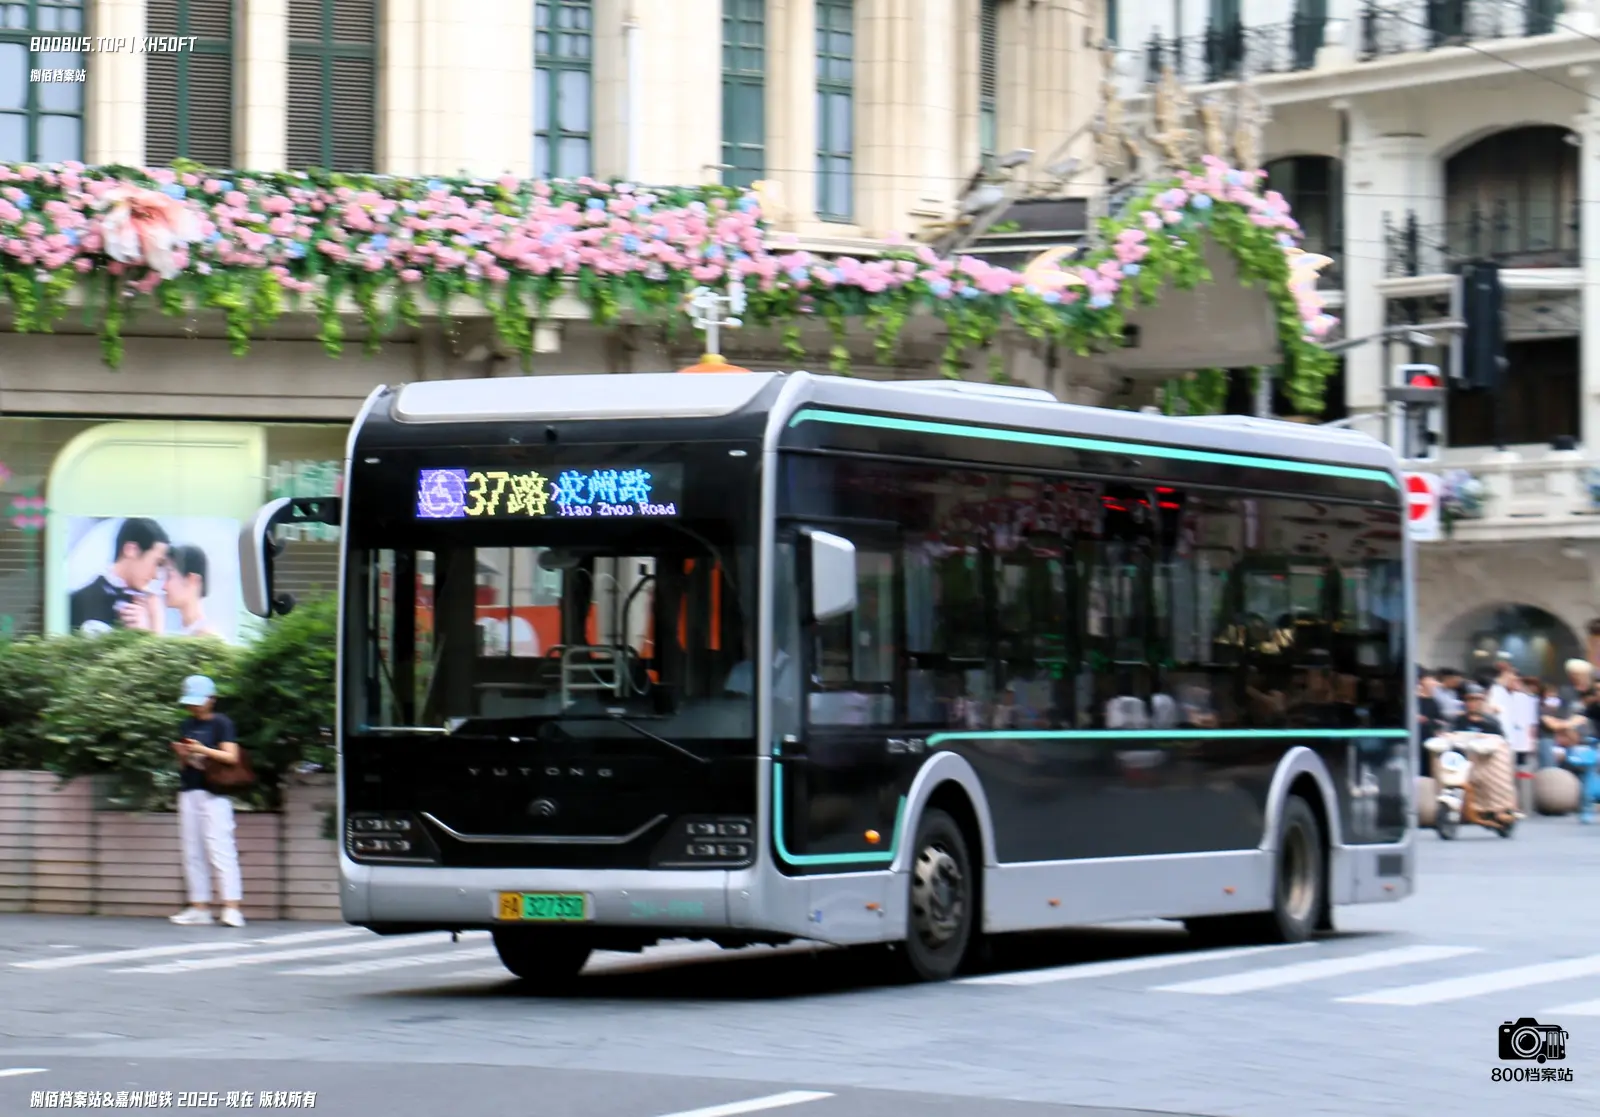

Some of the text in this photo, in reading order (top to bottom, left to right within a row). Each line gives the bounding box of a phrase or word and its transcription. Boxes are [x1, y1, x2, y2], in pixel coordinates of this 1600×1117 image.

[463, 470, 550, 516] 37路
[598, 502, 634, 516] Zhou
[639, 502, 676, 515] Road
[468, 767, 613, 778] YUTONG
